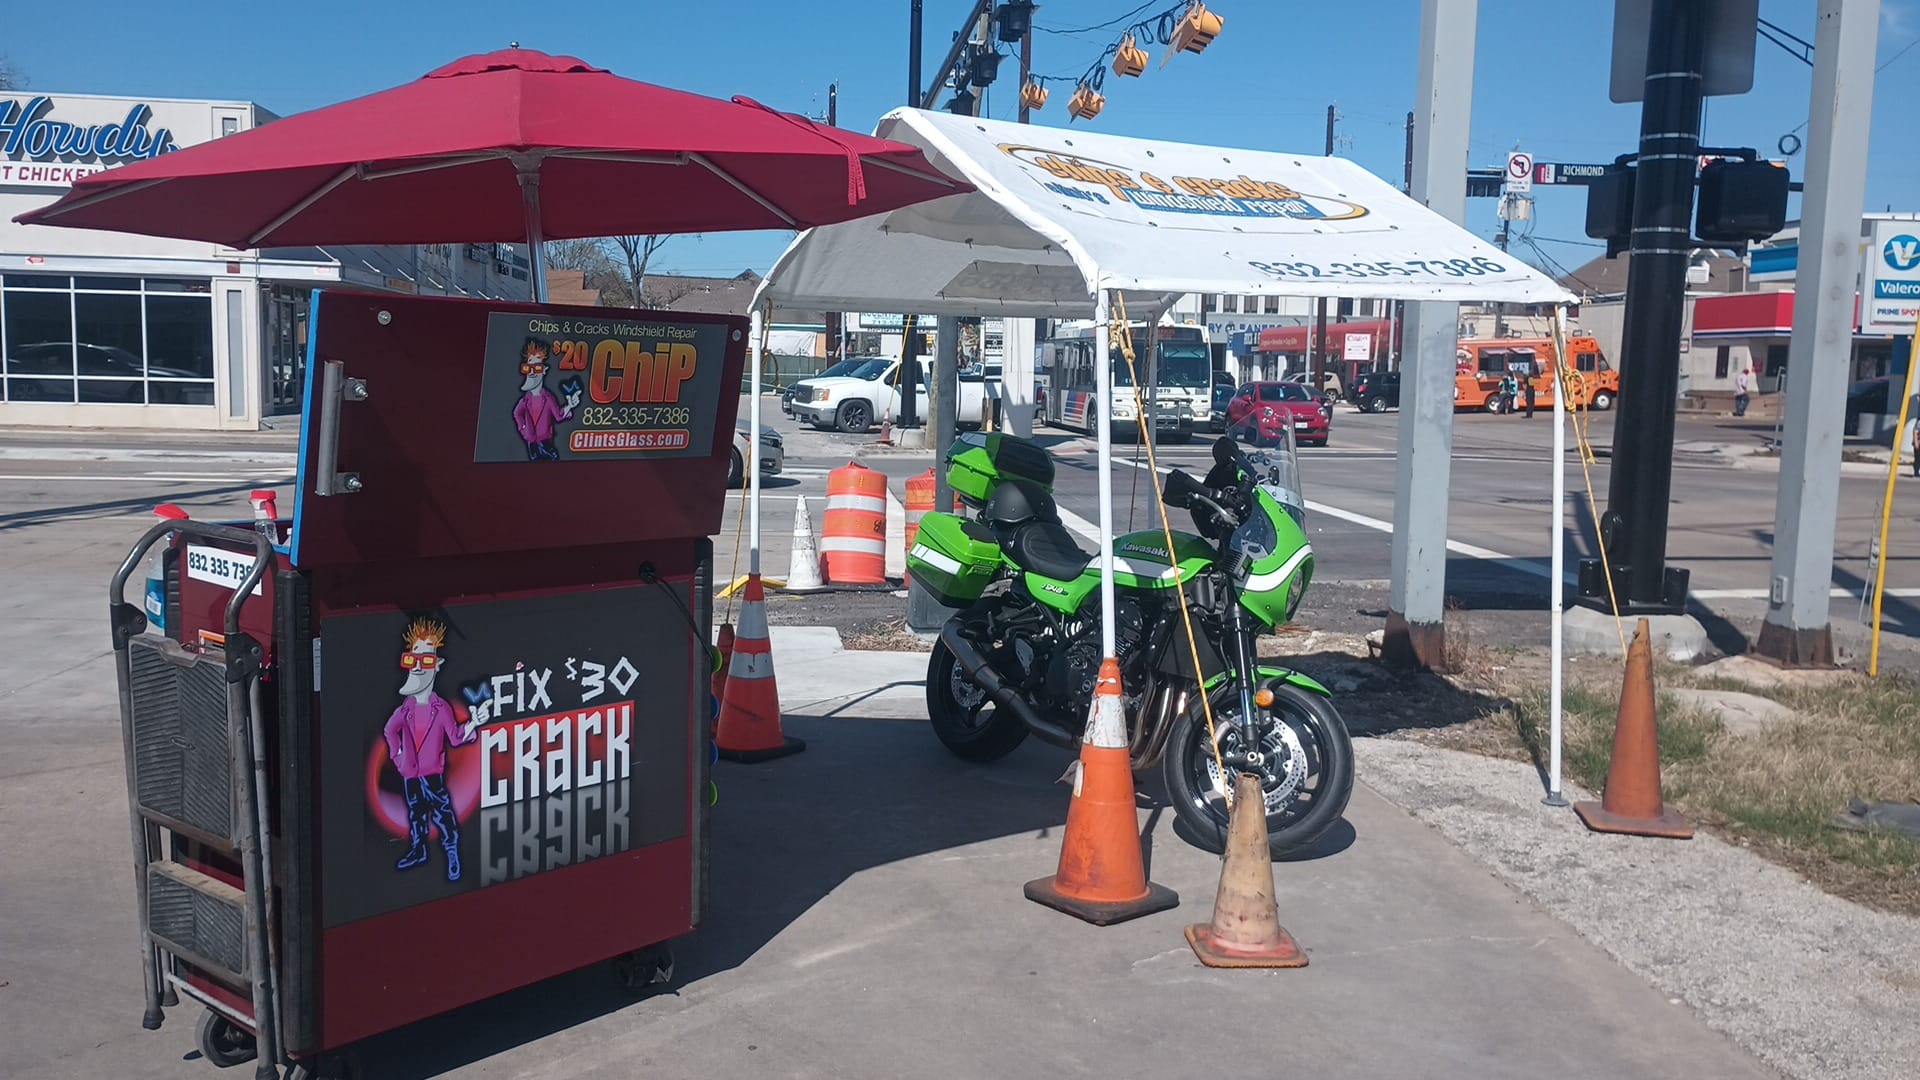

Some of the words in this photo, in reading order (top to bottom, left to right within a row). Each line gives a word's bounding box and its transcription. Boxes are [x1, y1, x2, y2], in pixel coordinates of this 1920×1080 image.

[1563, 165, 1605, 176] RICHMOND
[1172, 175, 1301, 200] cracks
[1128, 190, 1245, 214] windshield
[1246, 200, 1310, 219] repair
[1249, 257, 1507, 278] 832-335-7386
[1880, 282, 1920, 295] Valero
[1877, 308, 1900, 316] PRIME
[528, 319, 560, 334] Chips
[562, 321, 571, 333] &
[574, 321, 610, 335] Cracks
[612, 323, 665, 338] Windshield
[667, 325, 697, 339] Repair
[552, 340, 589, 371] $20
[582, 407, 690, 426] 832-335-7386
[573, 431, 685, 449] ClintsGlass.com
[1121, 542, 1170, 558] Kawasaki
[188, 551, 208, 572] 832
[210, 554, 230, 578] 335
[232, 561, 253, 582] 738
[565, 656, 640, 703] $30
